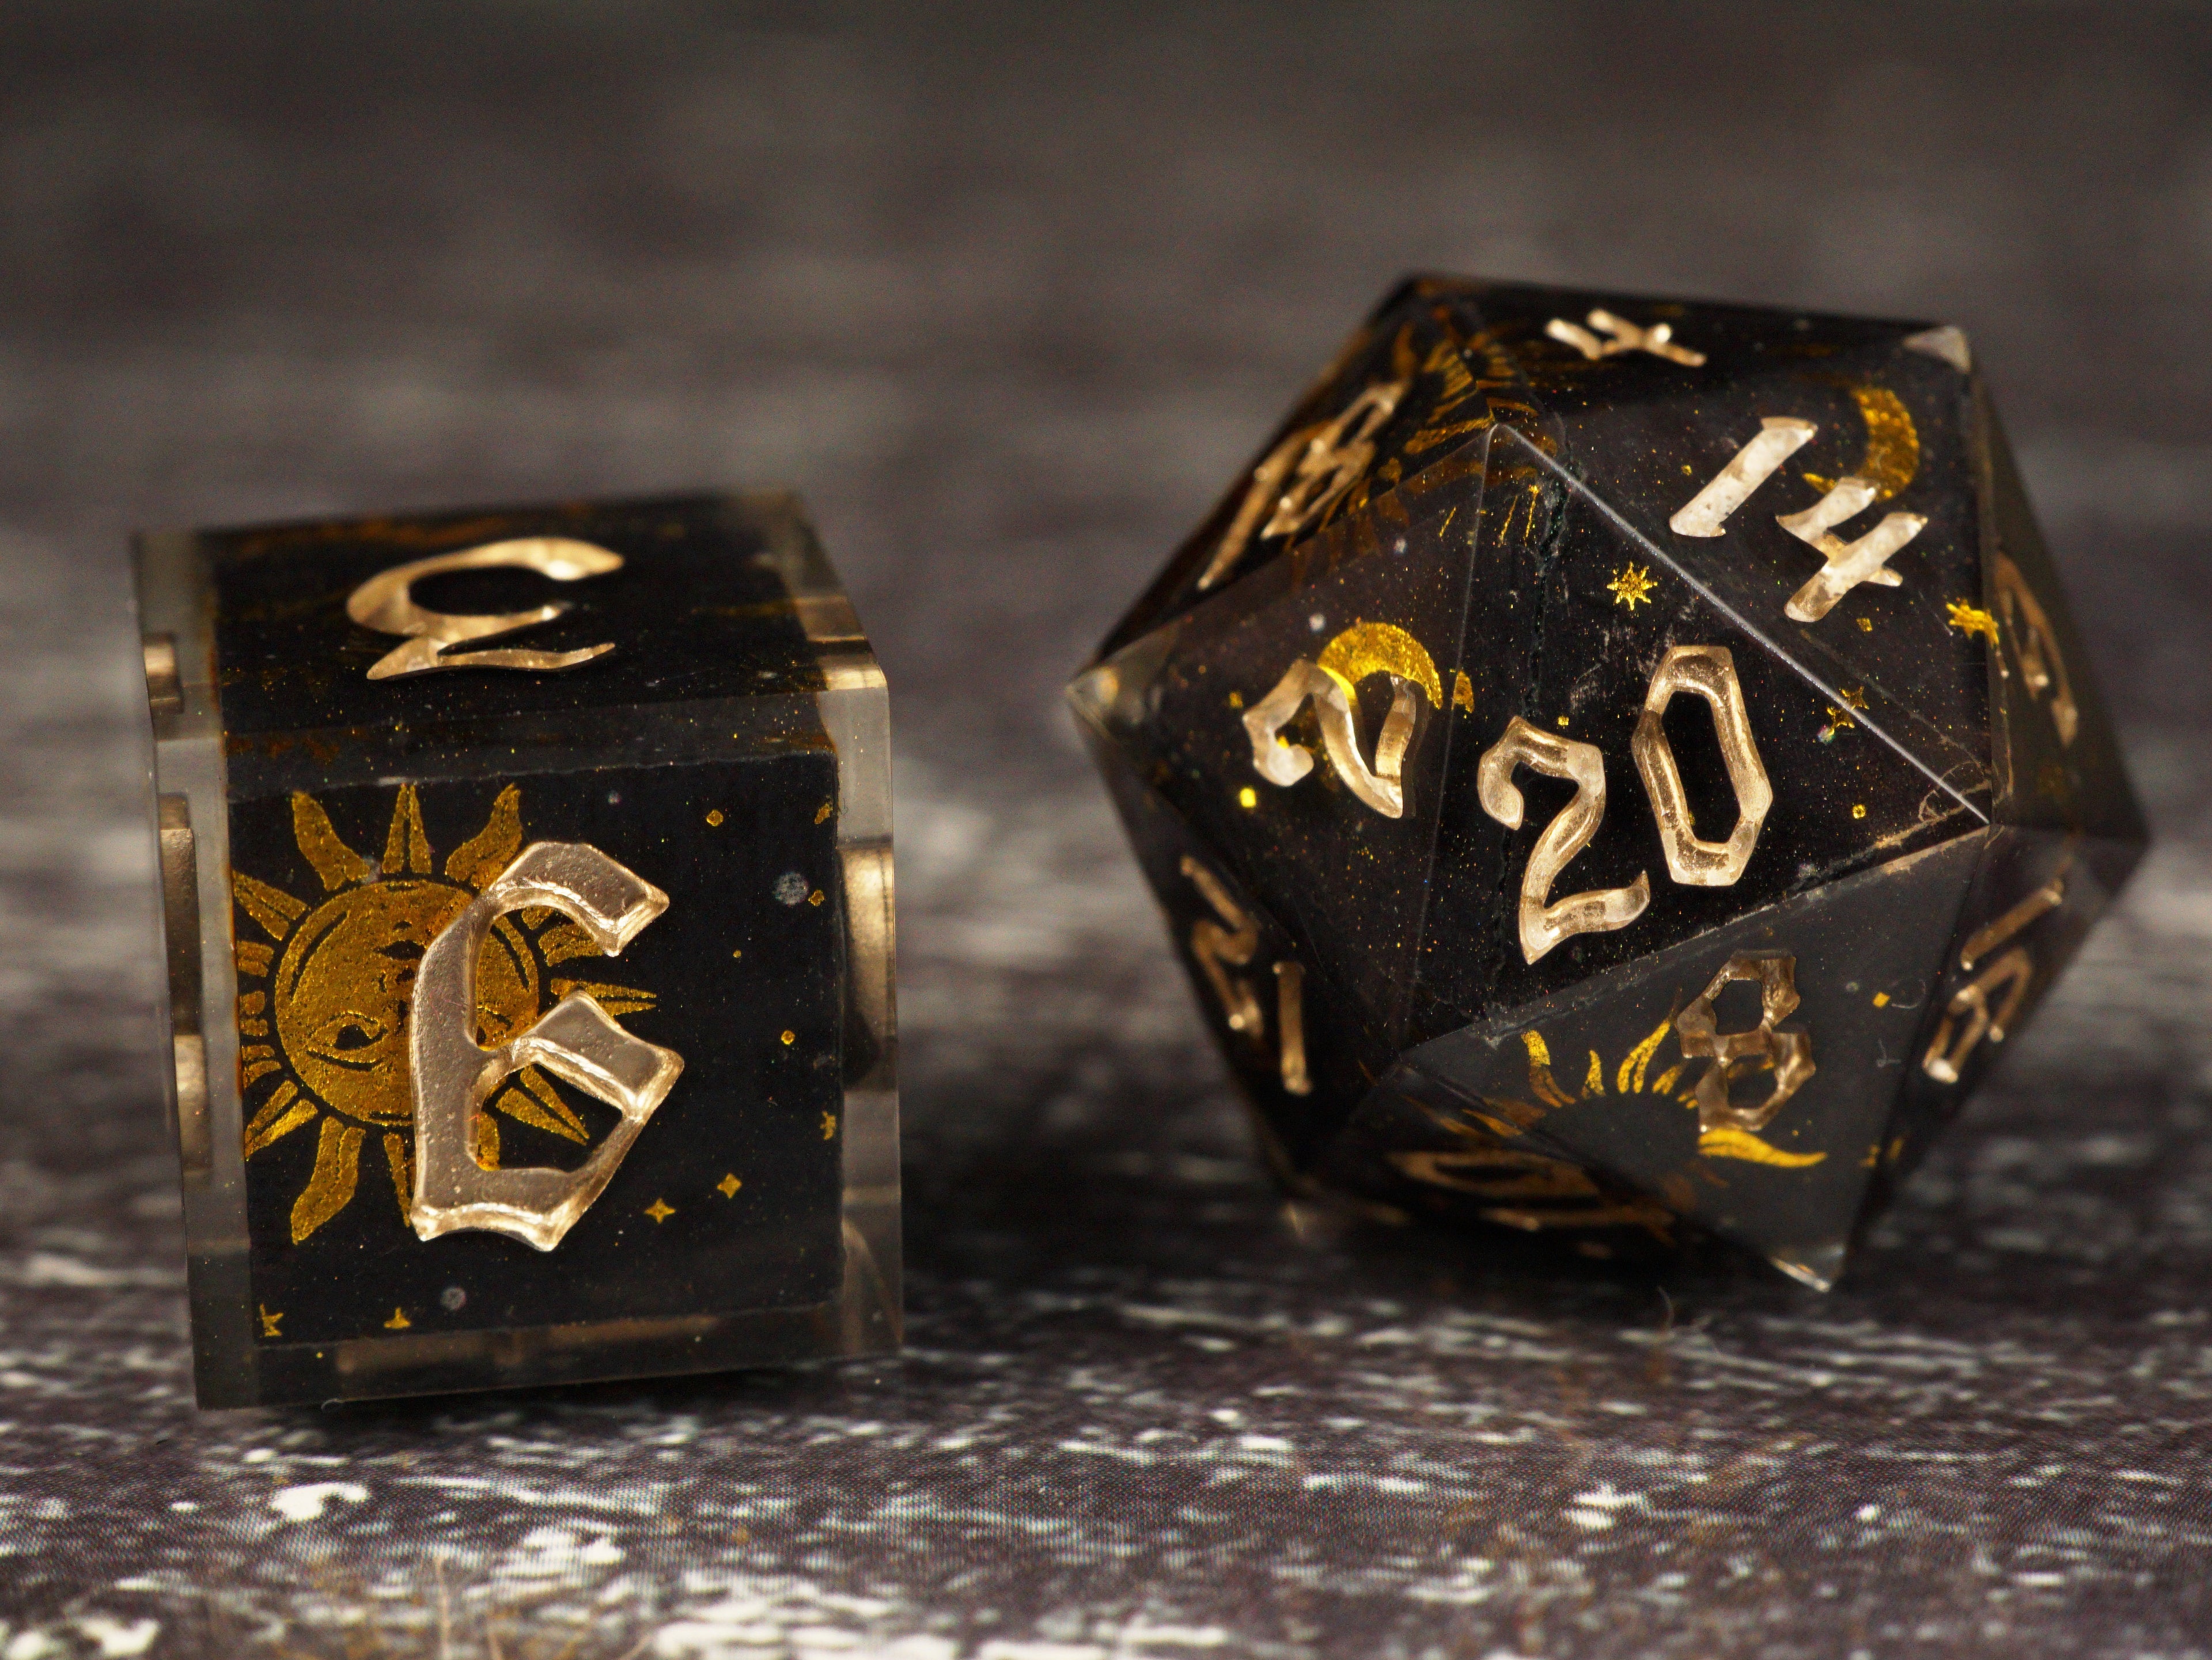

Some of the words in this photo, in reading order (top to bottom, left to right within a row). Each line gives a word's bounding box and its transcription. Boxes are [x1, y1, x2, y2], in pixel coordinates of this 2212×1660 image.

[1669, 417, 1928, 622] 14
[1477, 645, 1772, 964] 20
[410, 841, 684, 1251] 6
[1677, 949, 1816, 1132] 8
